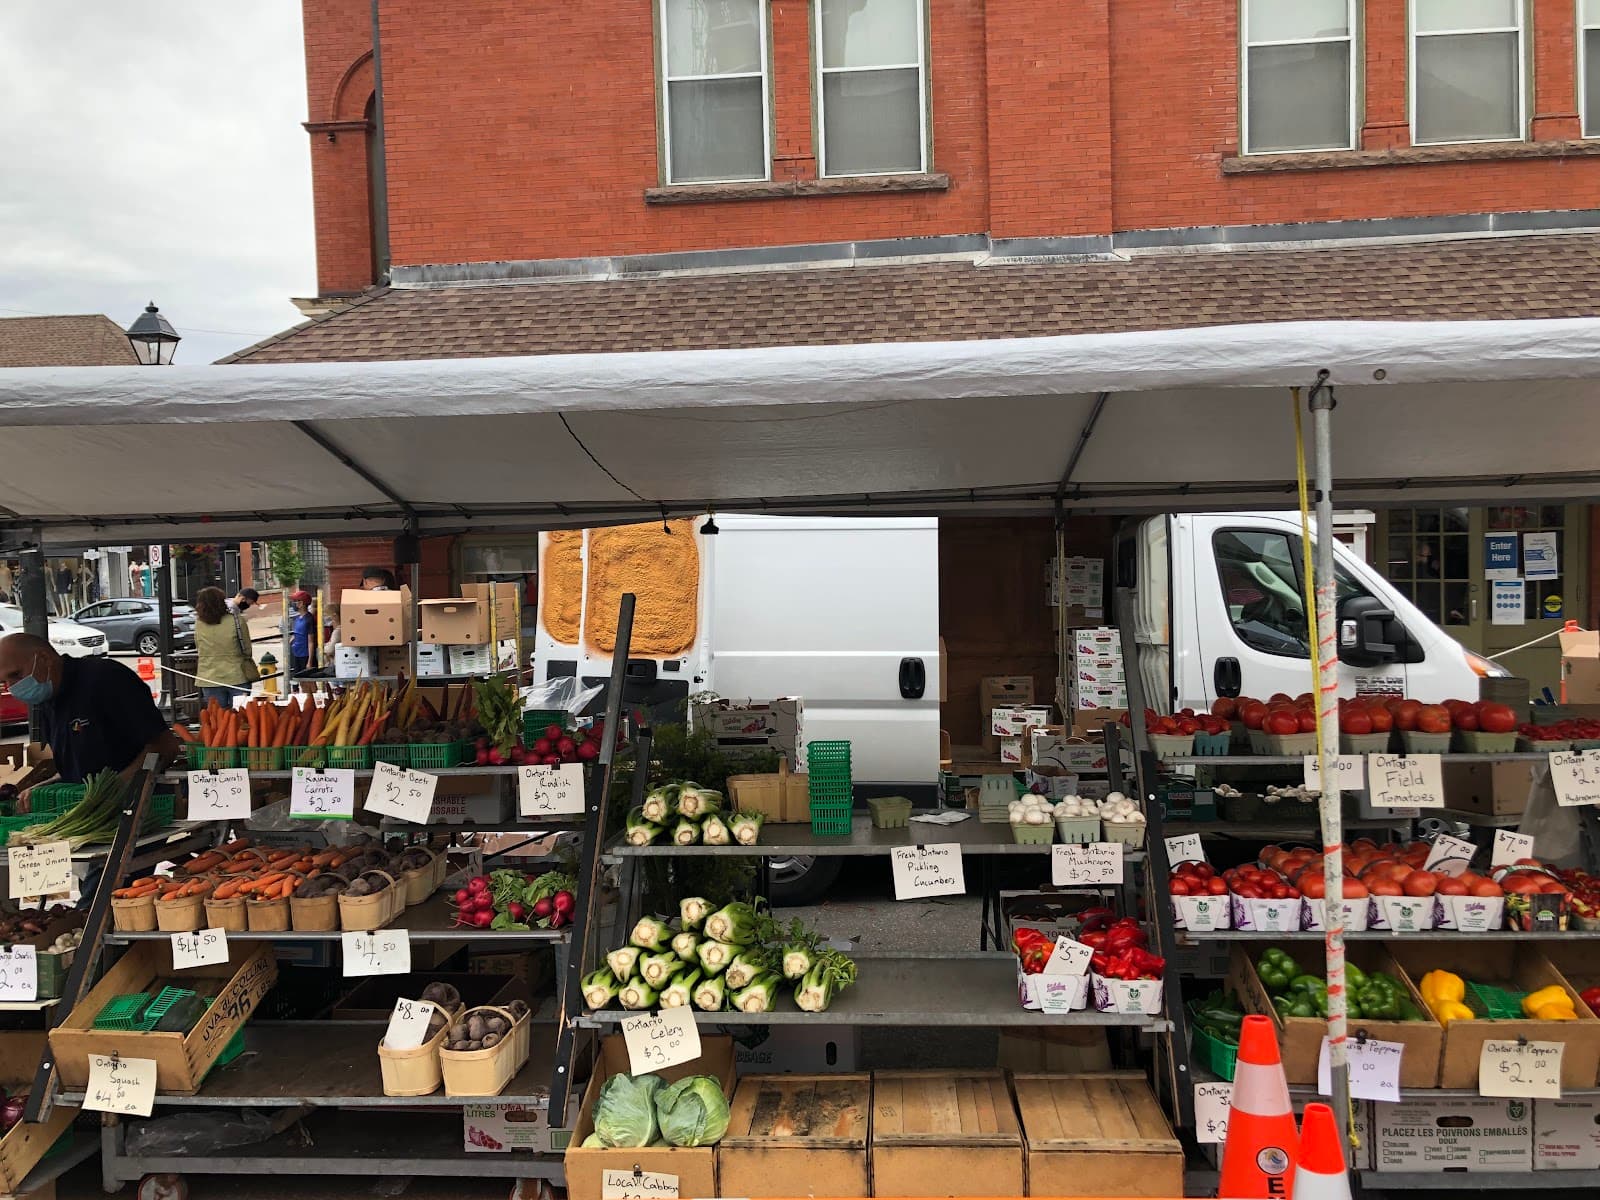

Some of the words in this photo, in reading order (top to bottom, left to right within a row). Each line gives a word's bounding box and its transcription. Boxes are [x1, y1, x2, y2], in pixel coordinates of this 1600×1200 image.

[1491, 542, 1512, 550] Enter
[1491, 553, 1511, 562] Here
[1376, 756, 1417, 770] Ontario
[1385, 769, 1424, 788] Field
[1377, 791, 1434, 803] Tomatoes
[896, 850, 916, 860] Fresh
[921, 848, 949, 858] Ontario
[1055, 847, 1076, 856] Fresh
[1082, 846, 1115, 856] Ontario
[18, 860, 41, 870] Green
[907, 861, 939, 874] Pickling
[914, 875, 955, 888] Cucumbers
[202, 1013, 222, 1042] UVA
[626, 1017, 663, 1032] Ontario
[650, 1025, 683, 1040] Celery
[466, 1110, 496, 1118] LITRES
[1382, 1127, 1416, 1138] PLACEZ
[1418, 1127, 1434, 1138] LES
[1436, 1127, 1481, 1138] POIVRONS
[1438, 1137, 1458, 1145] DOUX
[608, 1173, 637, 1189] Local
